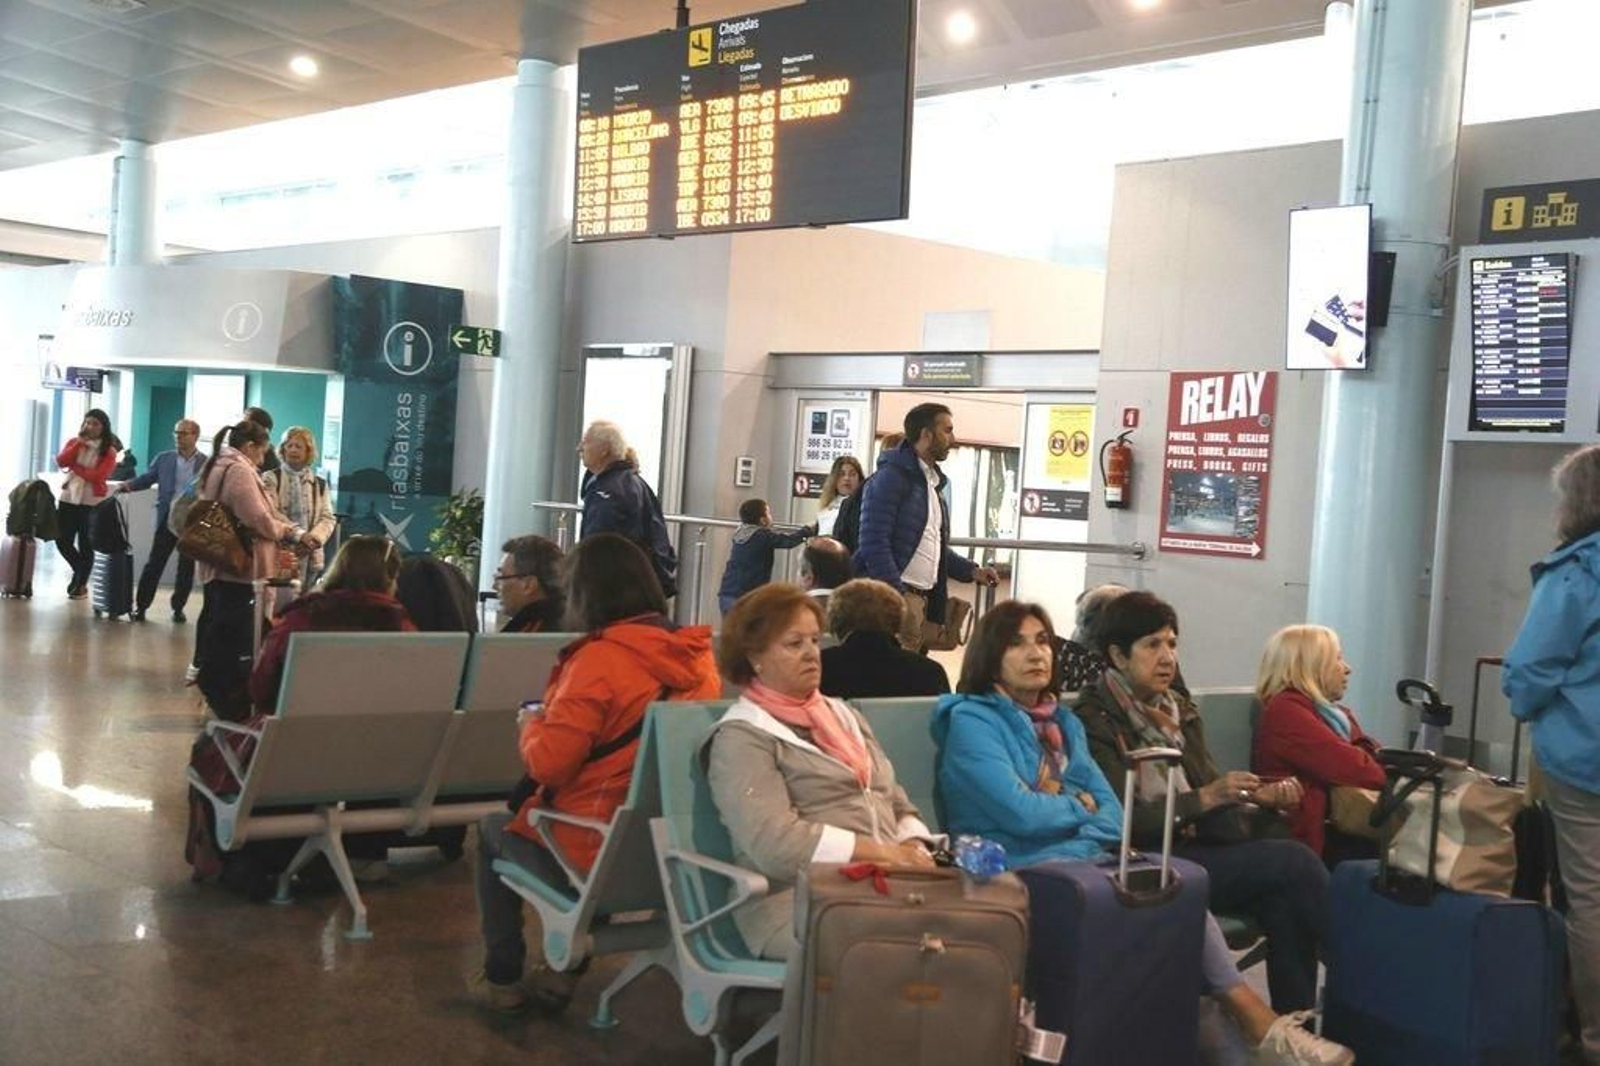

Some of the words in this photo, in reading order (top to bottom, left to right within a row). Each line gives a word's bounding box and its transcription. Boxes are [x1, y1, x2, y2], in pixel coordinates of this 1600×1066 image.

[719, 18, 759, 35] Chegadas
[718, 48, 755, 64] Llegadas
[735, 206, 771, 224] 17:00
[1180, 371, 1267, 425] RELAY
[389, 392, 412, 510] riasbaixas
[1166, 459, 1197, 471] PRESS,
[1203, 460, 1235, 472] BOOKS,
[1242, 461, 1268, 472] GIFTS
